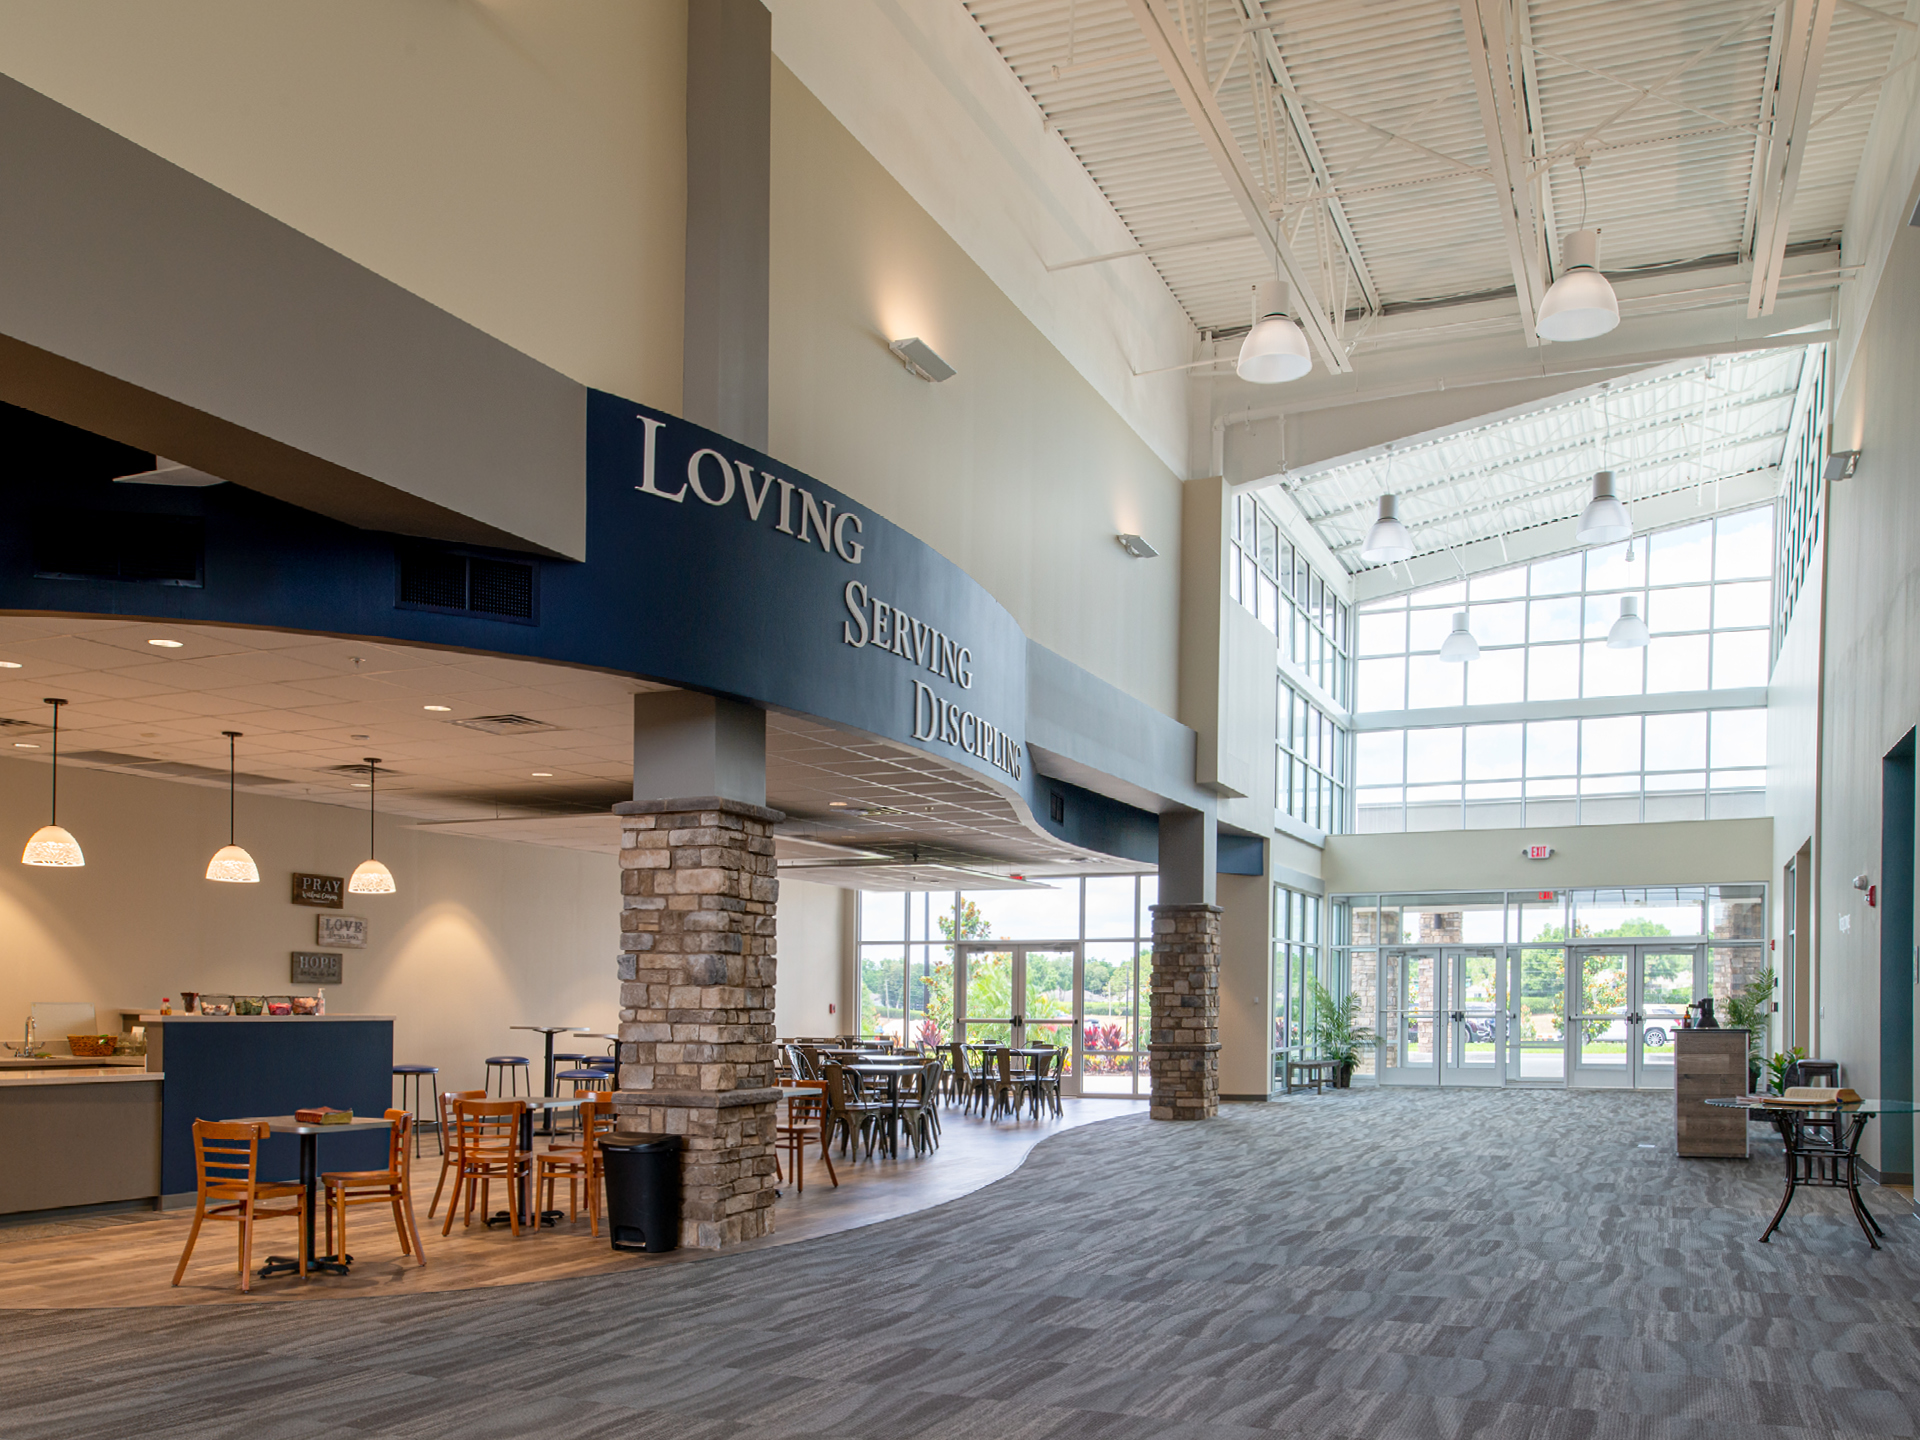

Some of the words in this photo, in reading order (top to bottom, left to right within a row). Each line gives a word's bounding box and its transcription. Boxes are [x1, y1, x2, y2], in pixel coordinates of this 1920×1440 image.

[634, 414, 864, 564] LOVING
[843, 580, 973, 690] SERVING
[911, 679, 1022, 782] DISCIPLING
[1531, 846, 1547, 858] EXIT
[302, 877, 341, 893] PRAY
[325, 918, 363, 933] LOVE
[300, 956, 337, 969] HOPE
